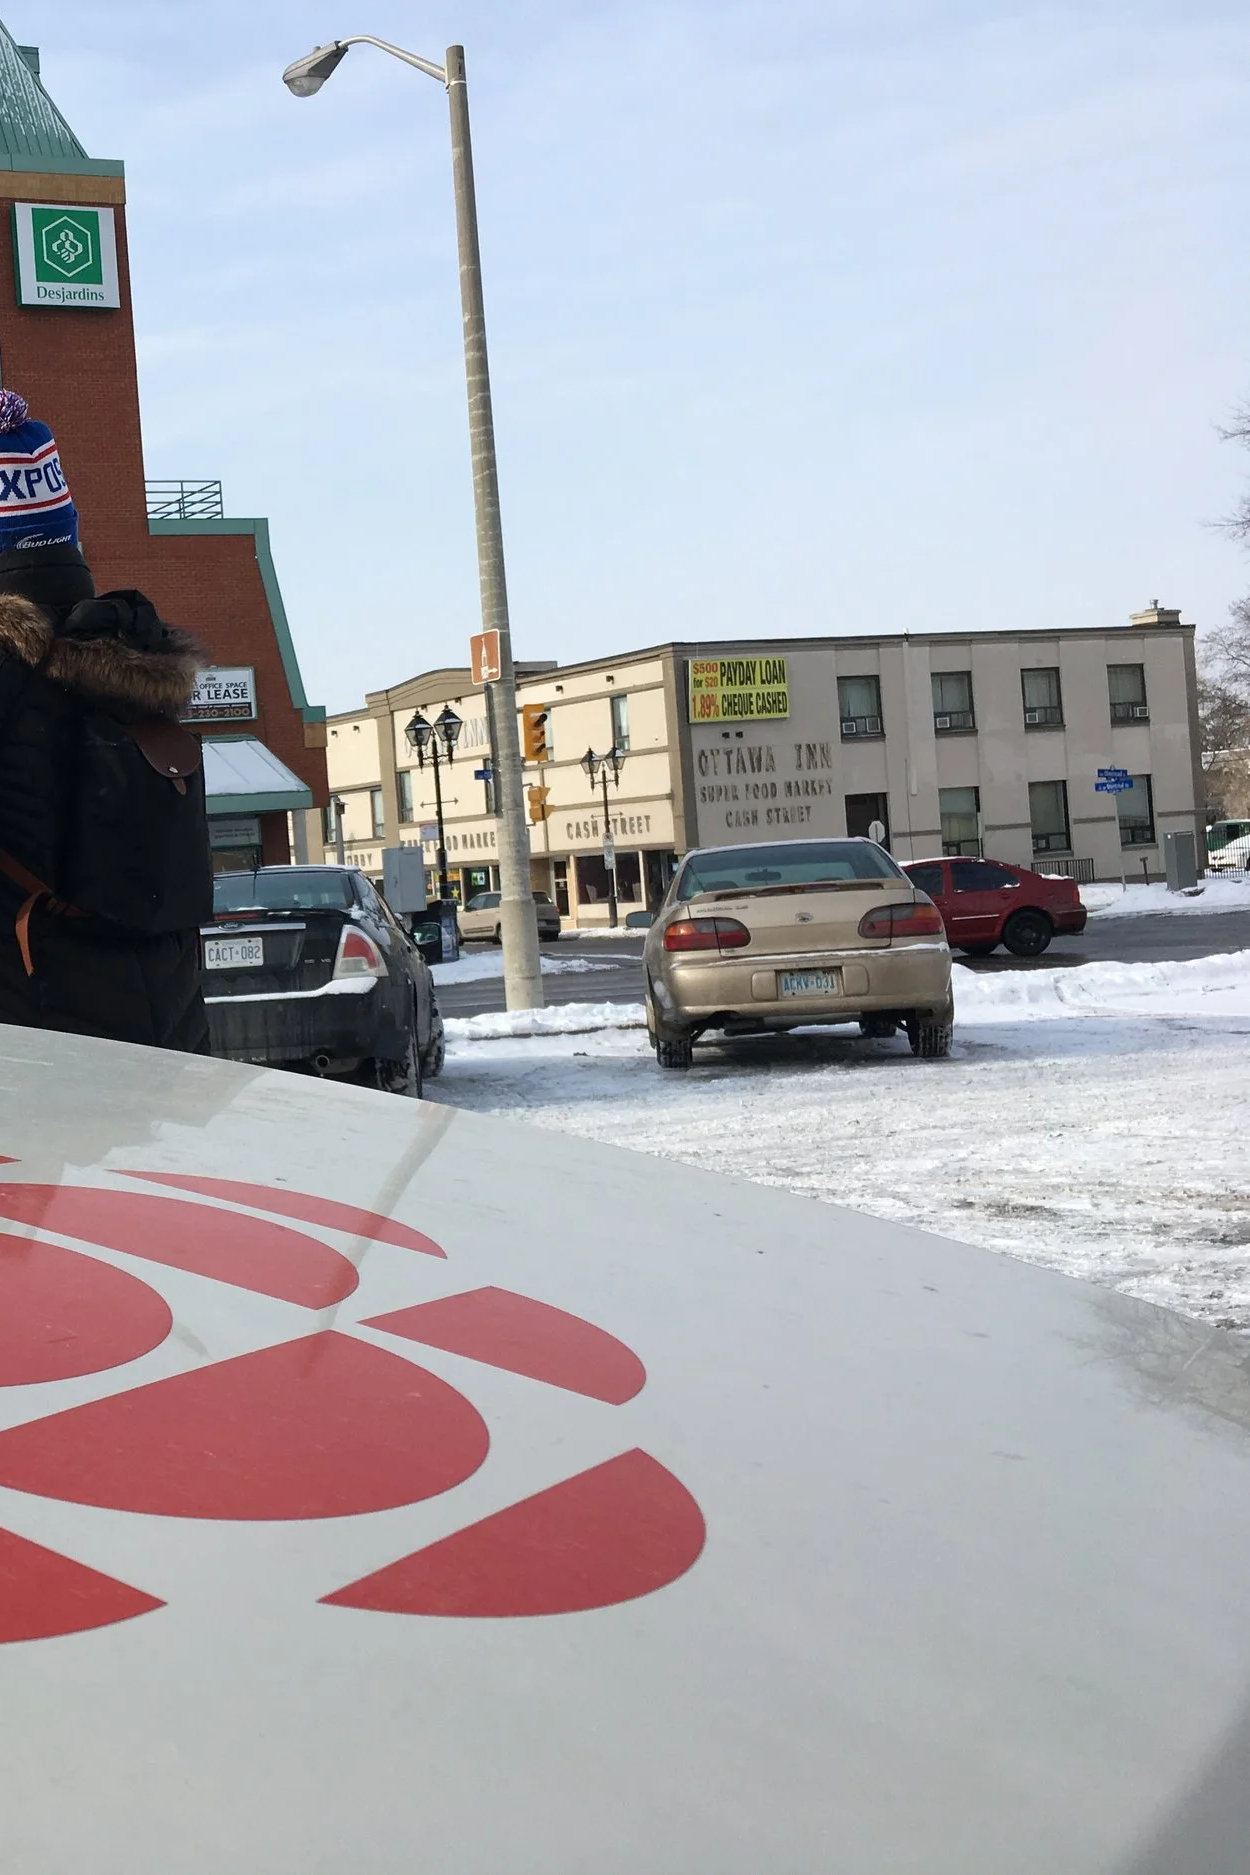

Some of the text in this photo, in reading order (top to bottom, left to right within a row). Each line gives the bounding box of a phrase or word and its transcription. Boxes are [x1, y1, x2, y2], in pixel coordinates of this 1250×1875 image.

[36, 286, 105, 303] Desjardins
[692, 662, 718, 675] $500
[719, 660, 786, 687] PAYDAY LOAN
[199, 681, 248, 690] OFFICE SPACE
[693, 677, 703, 688] for
[207, 688, 249, 700] LEASE
[692, 691, 788, 719] 1.89% CHEQUE CASHED
[698, 743, 832, 777] OTTAWA INN
[700, 778, 832, 803] SUPER FOOD MARKET
[725, 805, 812, 829] CASH STREET
[566, 815, 651, 840] CASH TREET
[461, 831, 496, 850] MARKE
[347, 853, 373, 867] OBBY
